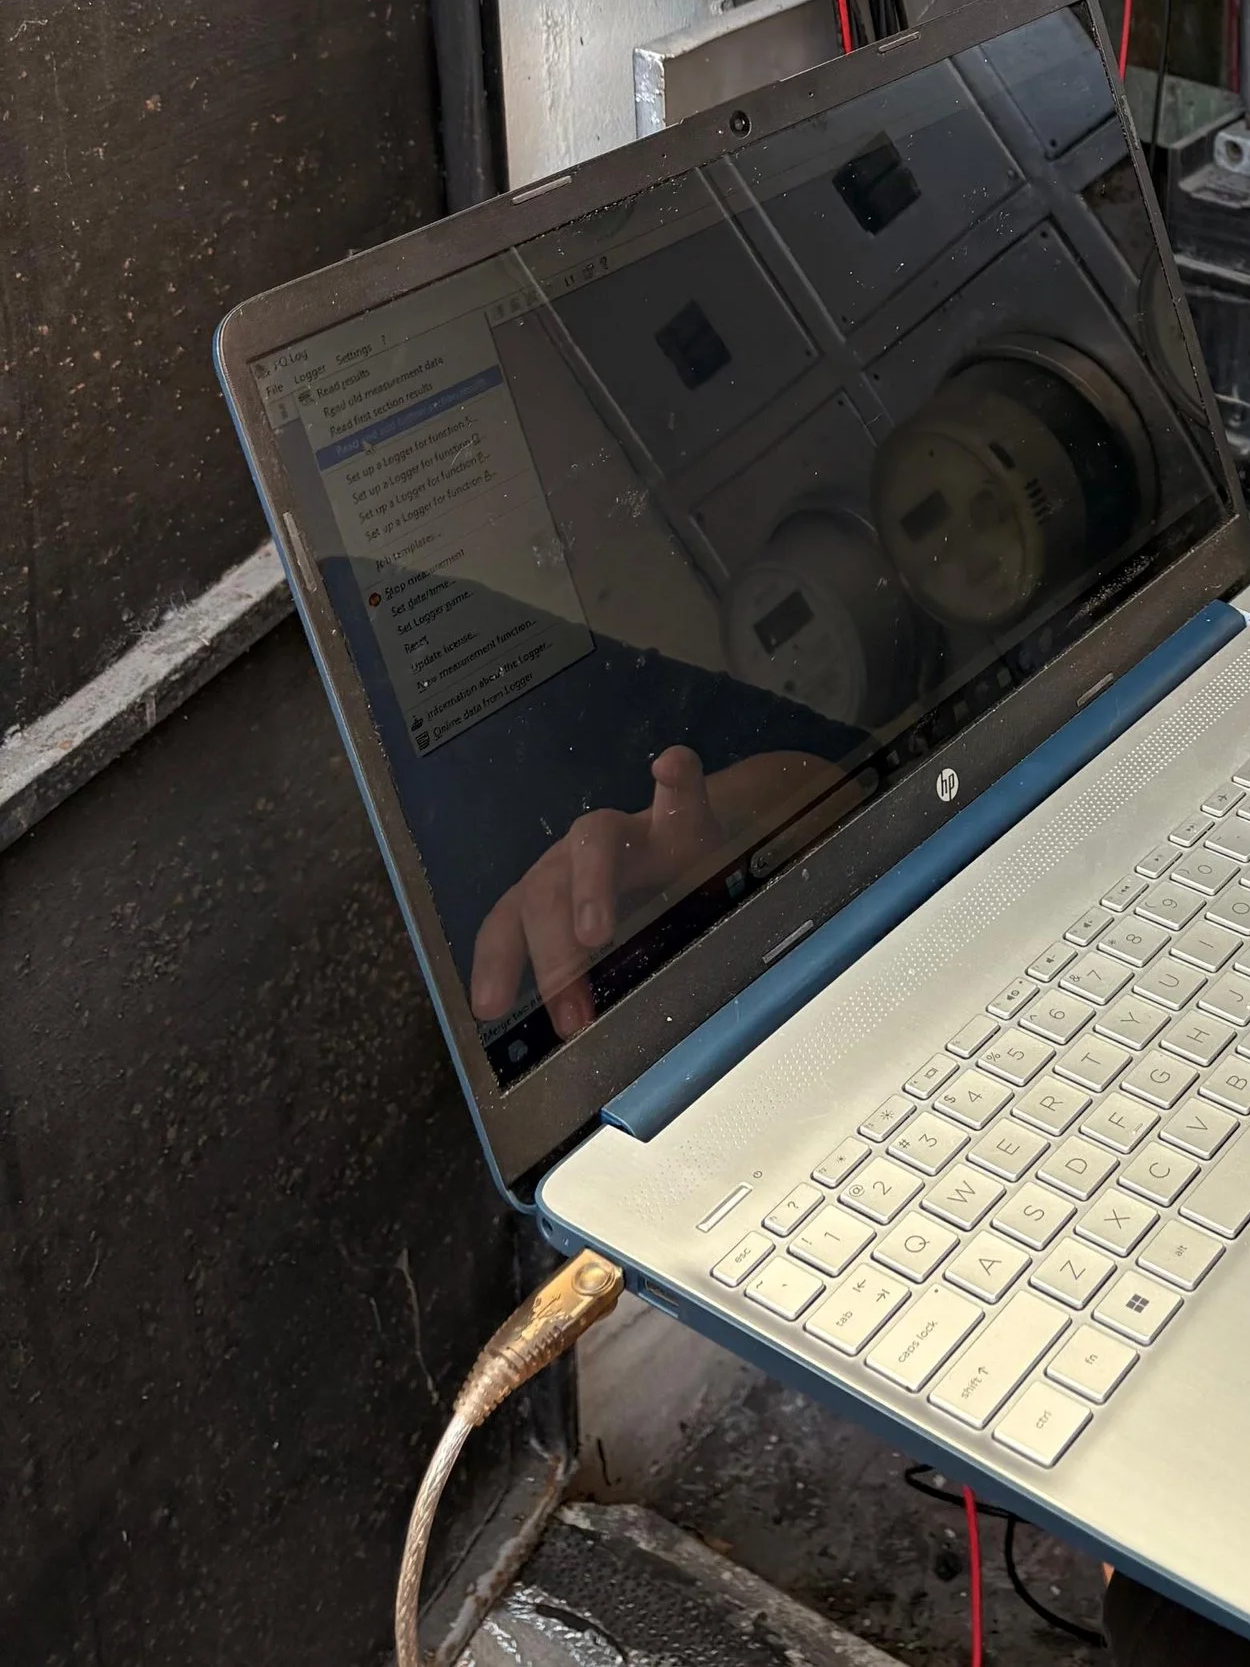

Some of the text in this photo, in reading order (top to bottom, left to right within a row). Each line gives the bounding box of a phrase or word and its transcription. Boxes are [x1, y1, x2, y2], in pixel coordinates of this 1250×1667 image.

[266, 384, 284, 397] File
[294, 365, 326, 385] Logger
[336, 344, 373, 365] Settings
[316, 369, 370, 399] Read results
[323, 356, 444, 418] Read old measurement data
[329, 382, 433, 437] Read first section results
[346, 471, 360, 485] Set
[362, 465, 374, 478] up
[384, 446, 413, 467] Logger
[414, 439, 427, 451] for
[428, 421, 465, 444] function
[352, 490, 367, 505] Set
[369, 485, 380, 497] up
[389, 465, 419, 486] Logger
[420, 457, 433, 469] for
[434, 439, 471, 461] function
[358, 510, 373, 525] Set
[375, 503, 388, 515] up
[395, 484, 425, 504] Logger
[427, 476, 440, 487] for
[440, 457, 477, 479] function
[365, 527, 381, 542] Set
[383, 521, 394, 534] up
[401, 502, 432, 523] Logger
[433, 494, 446, 506] for
[446, 476, 483, 499] function
[407, 548, 465, 585] measurement
[391, 604, 406, 618] Set
[397, 623, 412, 636] Set
[413, 605, 443, 624] Logger
[439, 639, 496, 679] measurement
[463, 704, 482, 720] data
[482, 690, 505, 707] from
[505, 672, 533, 695] Logger
[1162, 898, 1178, 910] 9
[1126, 933, 1142, 944] 8
[1087, 969, 1106, 982] 7
[1158, 974, 1180, 989] U
[1229, 988, 1244, 1002] J
[1049, 1008, 1066, 1020] 6
[1120, 1012, 1138, 1026] Y
[1186, 1027, 1210, 1043] H
[1007, 1047, 1025, 1061] 5
[1081, 1052, 1101, 1065] T
[1150, 1068, 1171, 1084] G
[1225, 1074, 1248, 1091] B
[968, 1090, 983, 1103] 4
[1040, 1096, 1064, 1112] R
[1108, 1111, 1127, 1128] F
[1187, 1117, 1208, 1131] V
[919, 1134, 937, 1148] 3
[996, 1138, 1021, 1156] E
[1065, 1158, 1088, 1175] D
[1149, 1162, 1170, 1179] C
[873, 1181, 892, 1195] 2
[947, 1180, 976, 1203] W
[1023, 1205, 1045, 1222] S
[1103, 1209, 1131, 1230] X
[824, 1231, 841, 1242] 1
[904, 1236, 930, 1253] Q
[734, 1246, 752, 1265] esc
[1175, 1245, 1187, 1257] alt
[980, 1256, 1003, 1275] A
[1060, 1260, 1086, 1280] Z
[836, 1310, 853, 1328] tab
[897, 1319, 938, 1363] caps lock
[1085, 1353, 1097, 1365] fn
[960, 1373, 984, 1400] shift
[1036, 1410, 1052, 1430] ctrl
